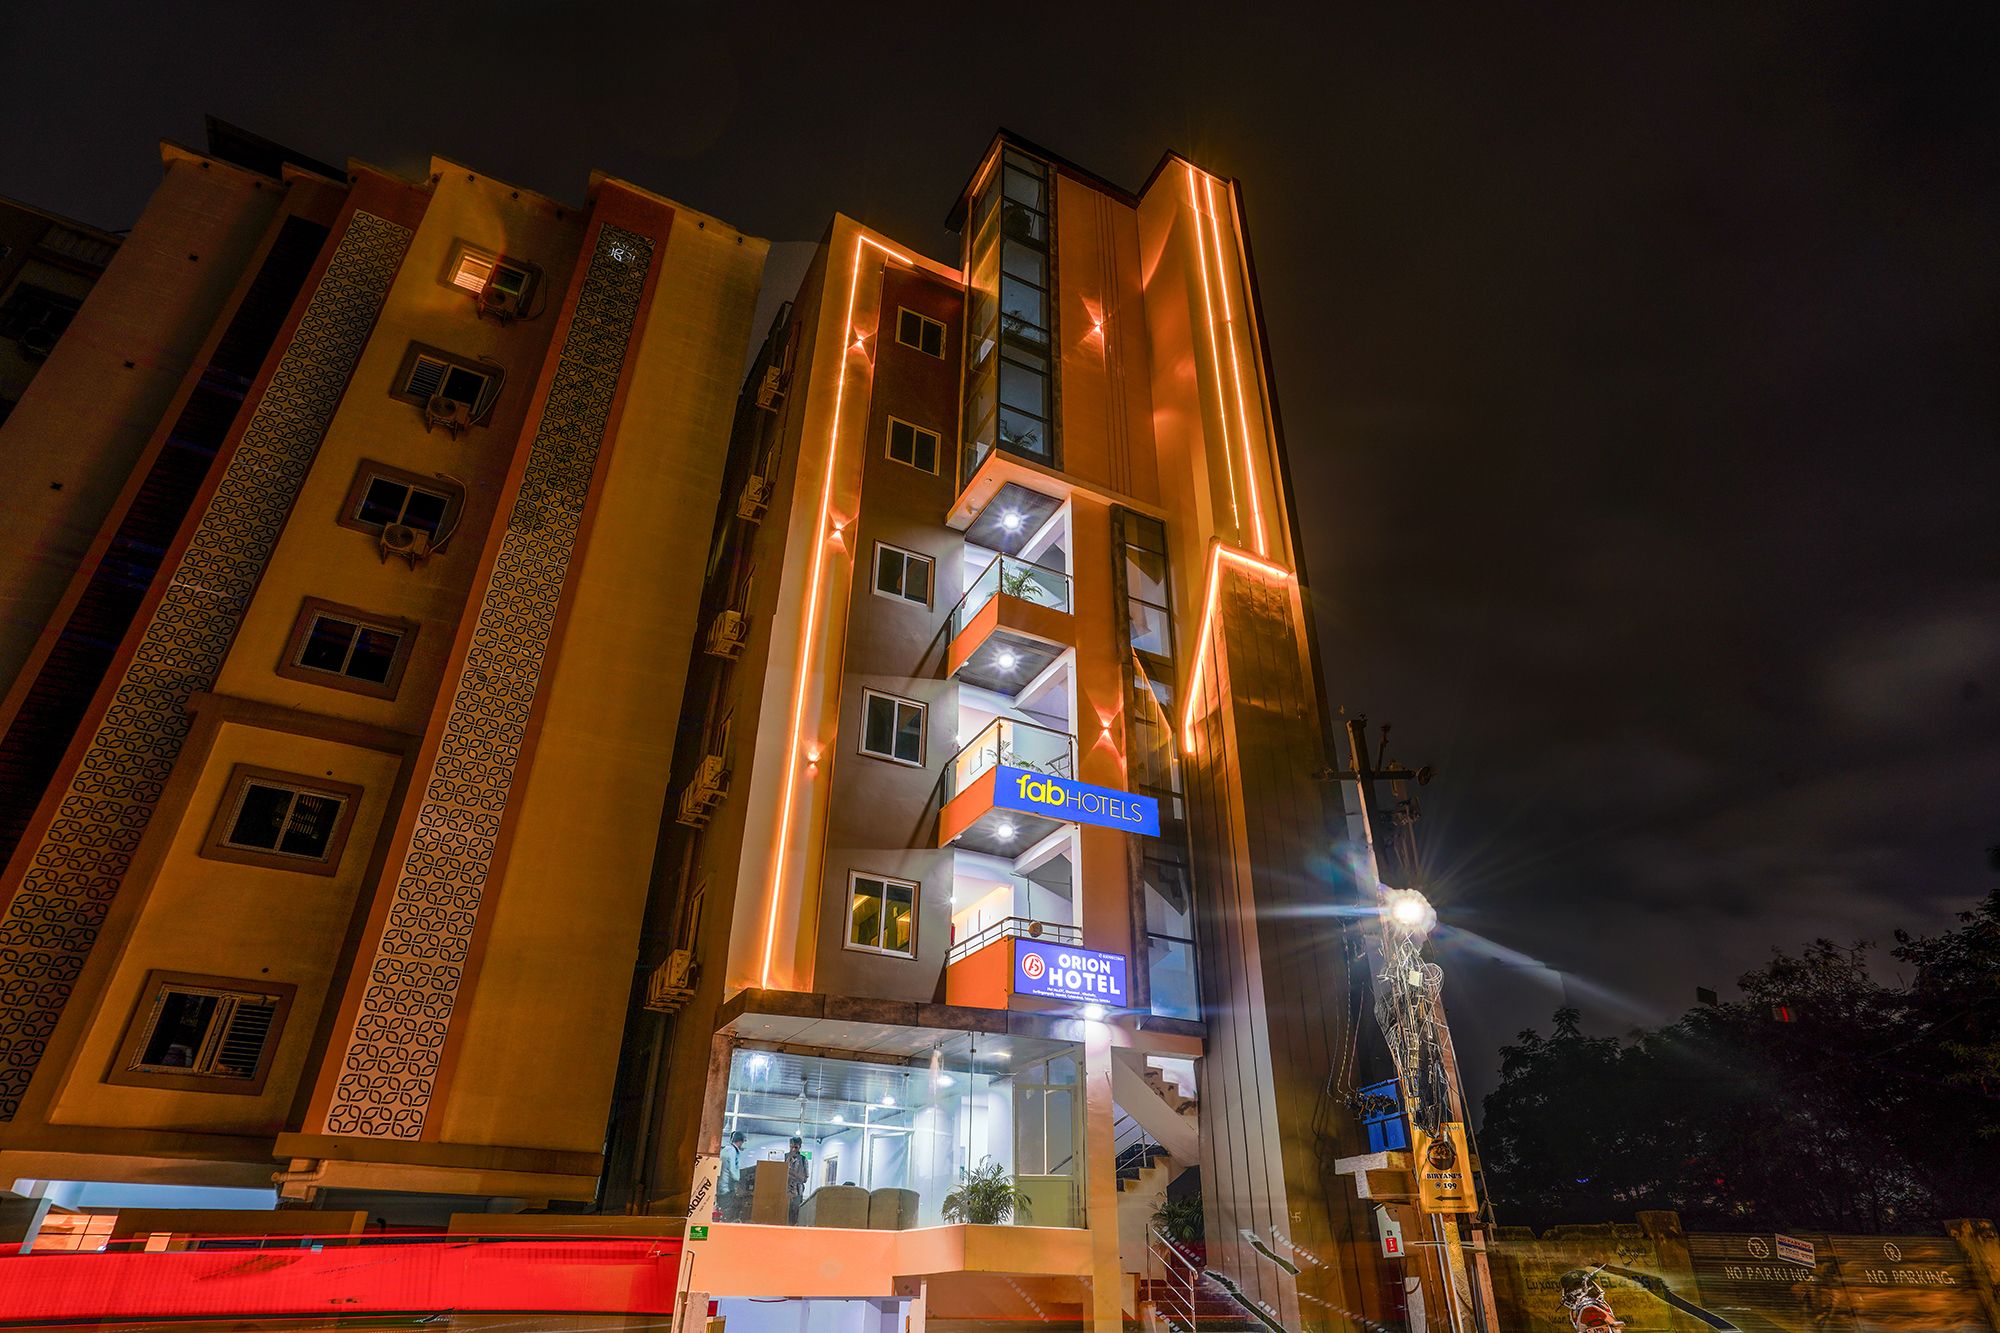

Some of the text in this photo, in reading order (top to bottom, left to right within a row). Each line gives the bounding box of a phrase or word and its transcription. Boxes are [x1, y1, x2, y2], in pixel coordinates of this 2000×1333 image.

[1058, 953, 1111, 974] ORION
[1049, 967, 1121, 995] HOTEL
[1443, 1182, 1458, 1190] 199
[1724, 1266, 1743, 1280] NO
[1865, 1269, 1888, 1284] NO
